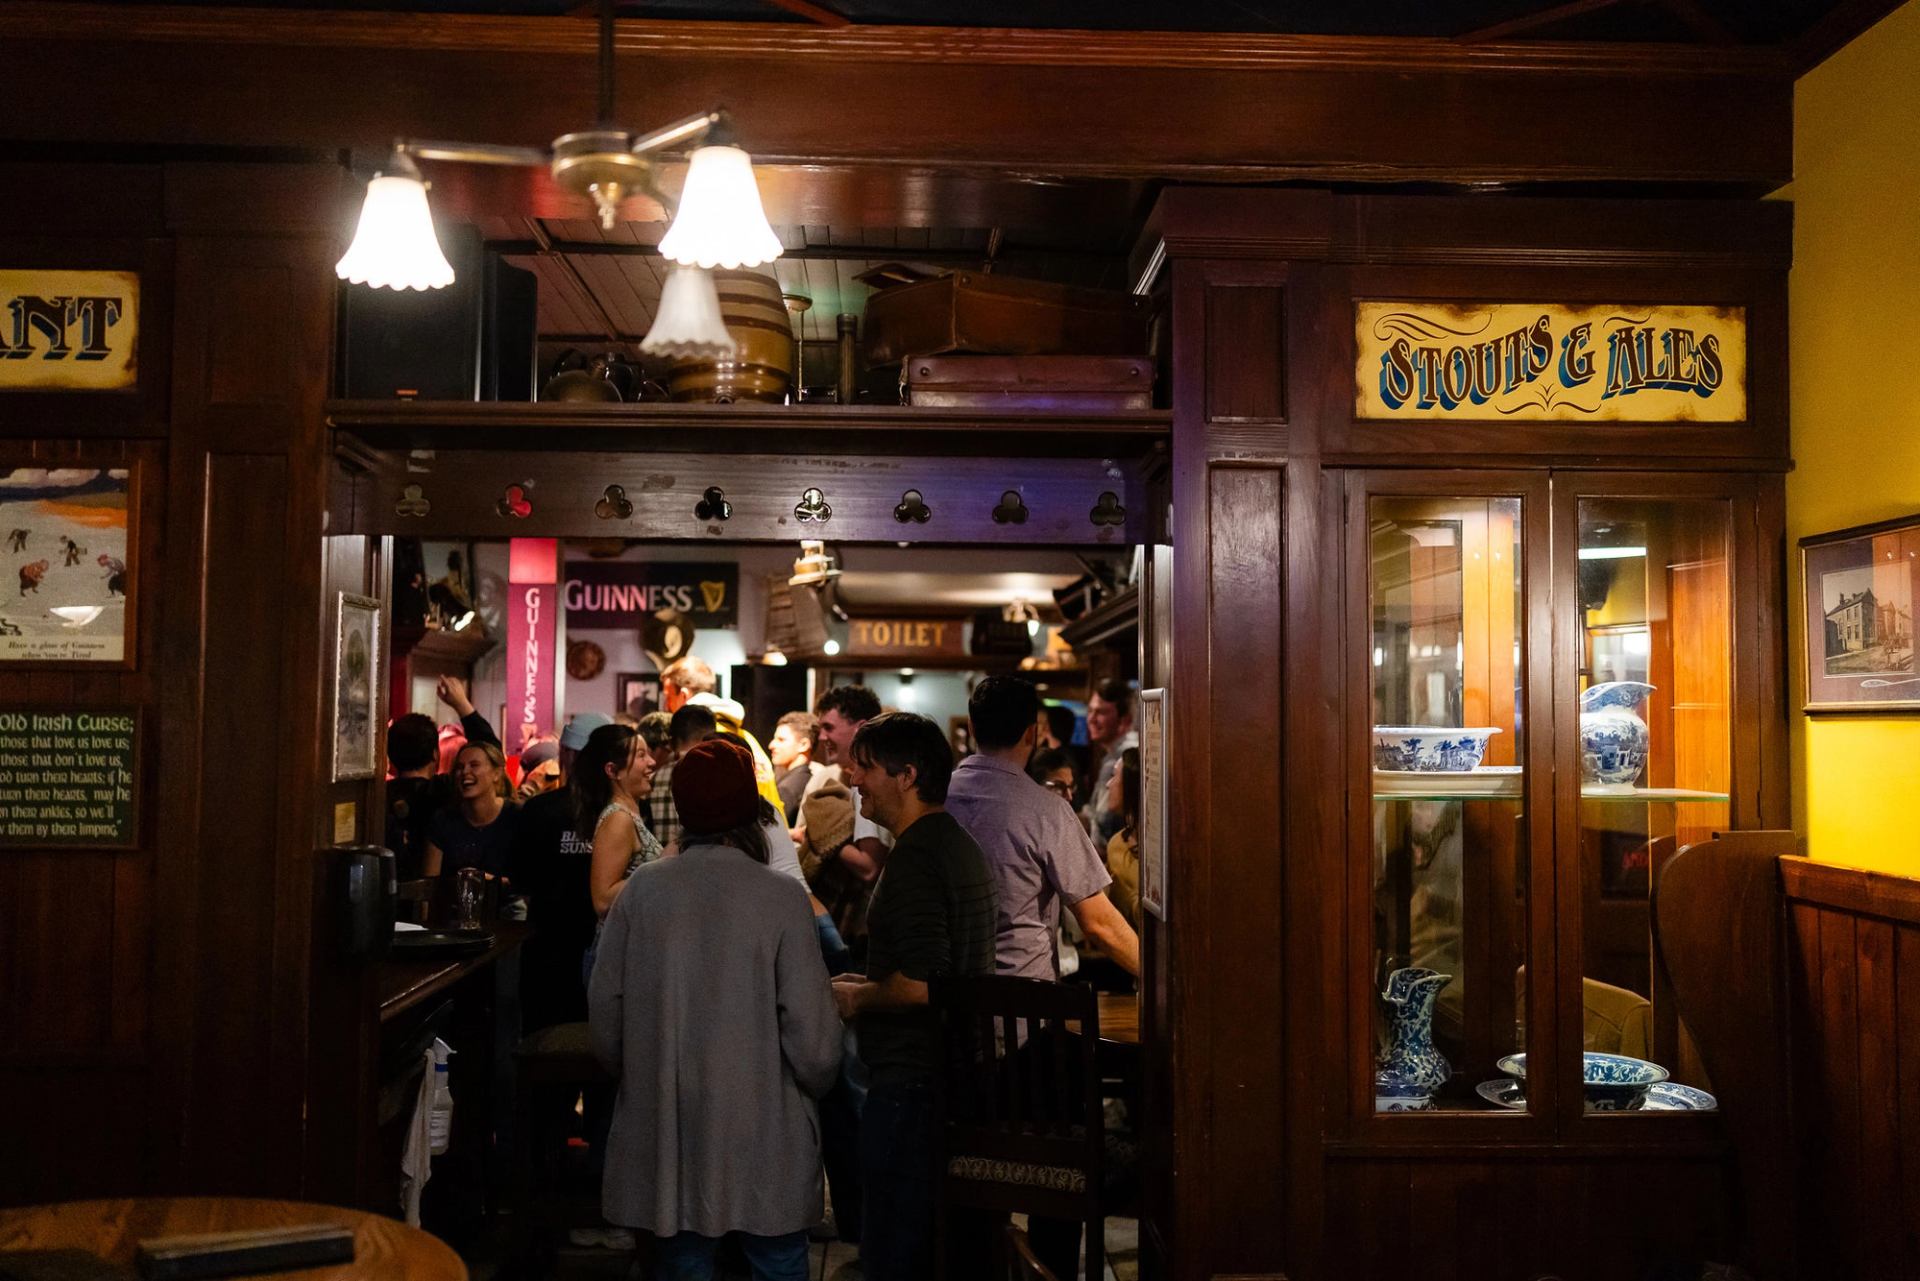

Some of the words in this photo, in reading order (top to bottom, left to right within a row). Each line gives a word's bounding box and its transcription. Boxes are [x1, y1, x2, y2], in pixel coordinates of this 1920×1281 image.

[0, 295, 123, 360] NT
[1379, 314, 1554, 410] STOUTS
[1559, 321, 1596, 389] &
[1601, 325, 1724, 399] ALES
[565, 580, 693, 612] GUINNESS
[859, 622, 948, 647] TOILET
[525, 588, 540, 723] GUINNESS
[0, 713, 28, 731] Old
[33, 713, 72, 731] Irish
[0, 735, 29, 749] those
[31, 735, 52, 748] that
[55, 735, 75, 748] love
[78, 737, 89, 748] us
[91, 735, 112, 748] love
[0, 753, 29, 766] those
[31, 753, 52, 766] that
[55, 753, 83, 766] don't
[85, 753, 106, 766] love
[16, 772, 39, 783] turn
[42, 770, 68, 784] their
[118, 767, 132, 784] he
[25, 788, 50, 800] their
[94, 790, 114, 803] may
[117, 785, 131, 801] he
[75, 807, 87, 818] so
[8, 822, 34, 835] them
[51, 822, 77, 835] their
